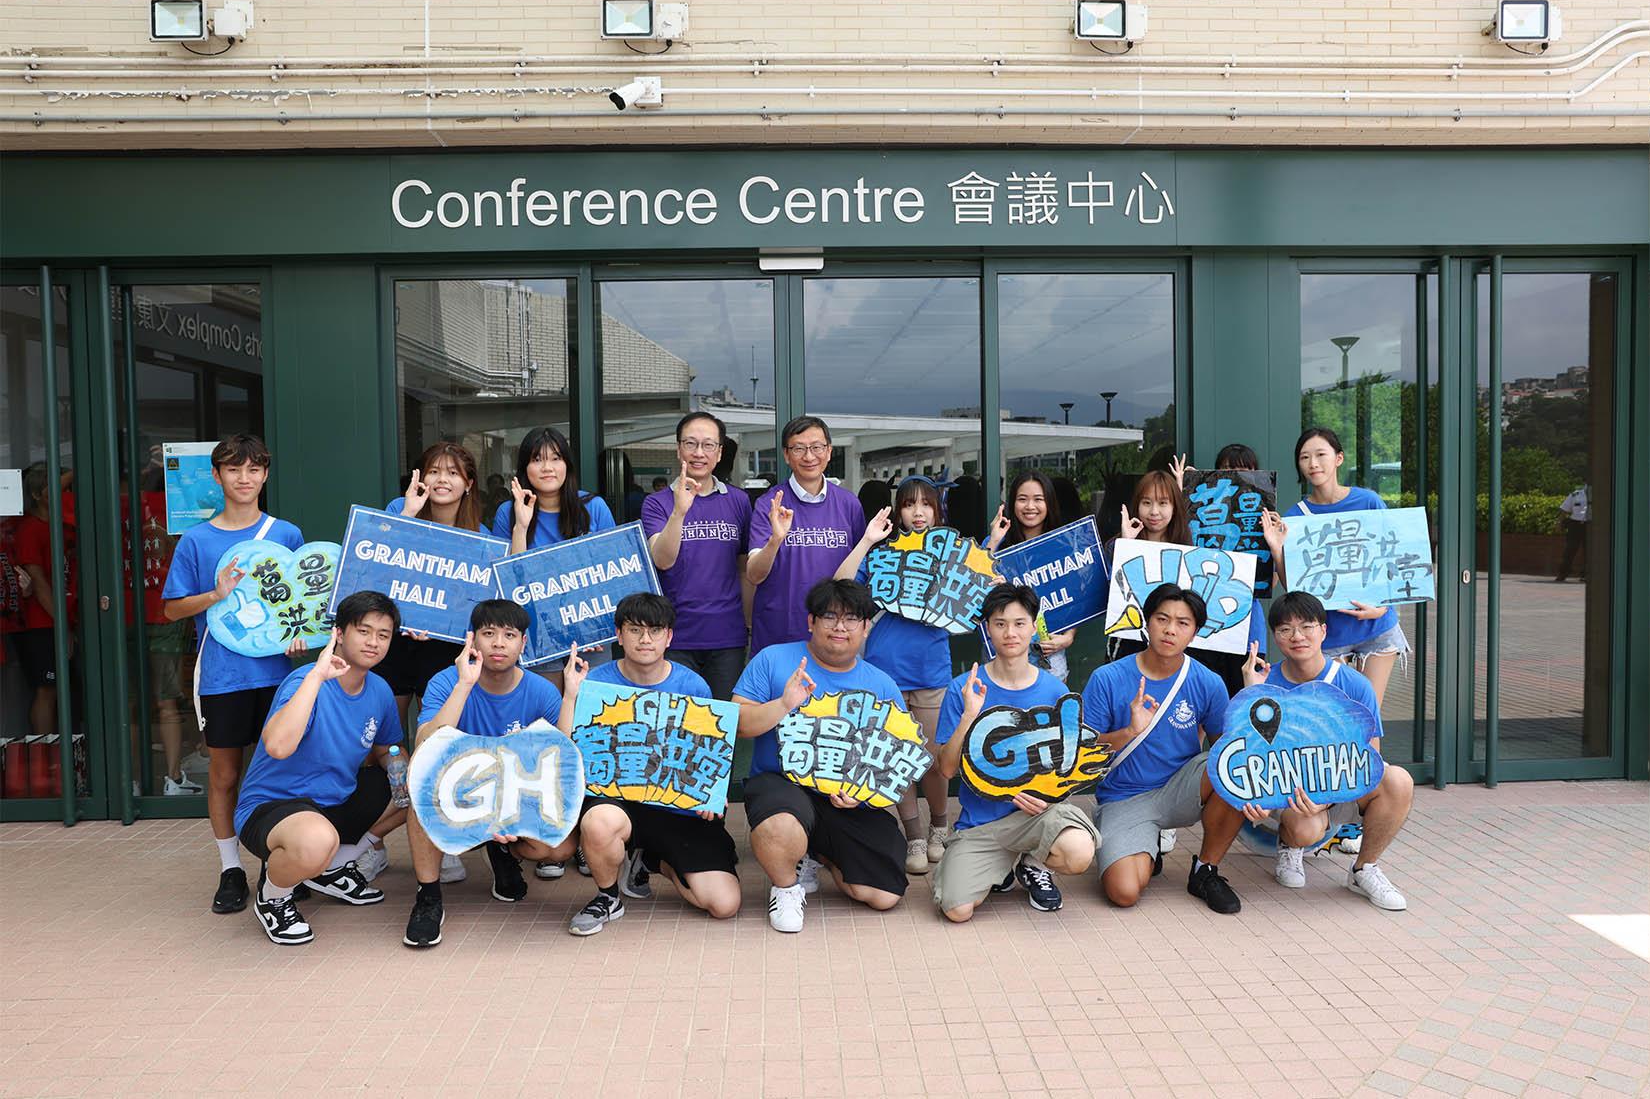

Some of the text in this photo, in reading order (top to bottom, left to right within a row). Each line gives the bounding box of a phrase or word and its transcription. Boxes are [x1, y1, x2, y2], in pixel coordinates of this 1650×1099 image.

[391, 174, 925, 228] Conference Centre
[947, 171, 1176, 226] 會議中心
[354, 539, 492, 586] GRANTHAM
[512, 554, 642, 606] GRANTHAM
[1012, 550, 1094, 590] ANTHAM
[388, 580, 448, 611] HALL
[560, 593, 617, 626] HALL
[1038, 589, 1074, 613] ALL
[635, 691, 687, 729] GH
[839, 691, 890, 729] GH
[438, 747, 561, 824] GH
[1217, 736, 1372, 801] GRANTHAM
